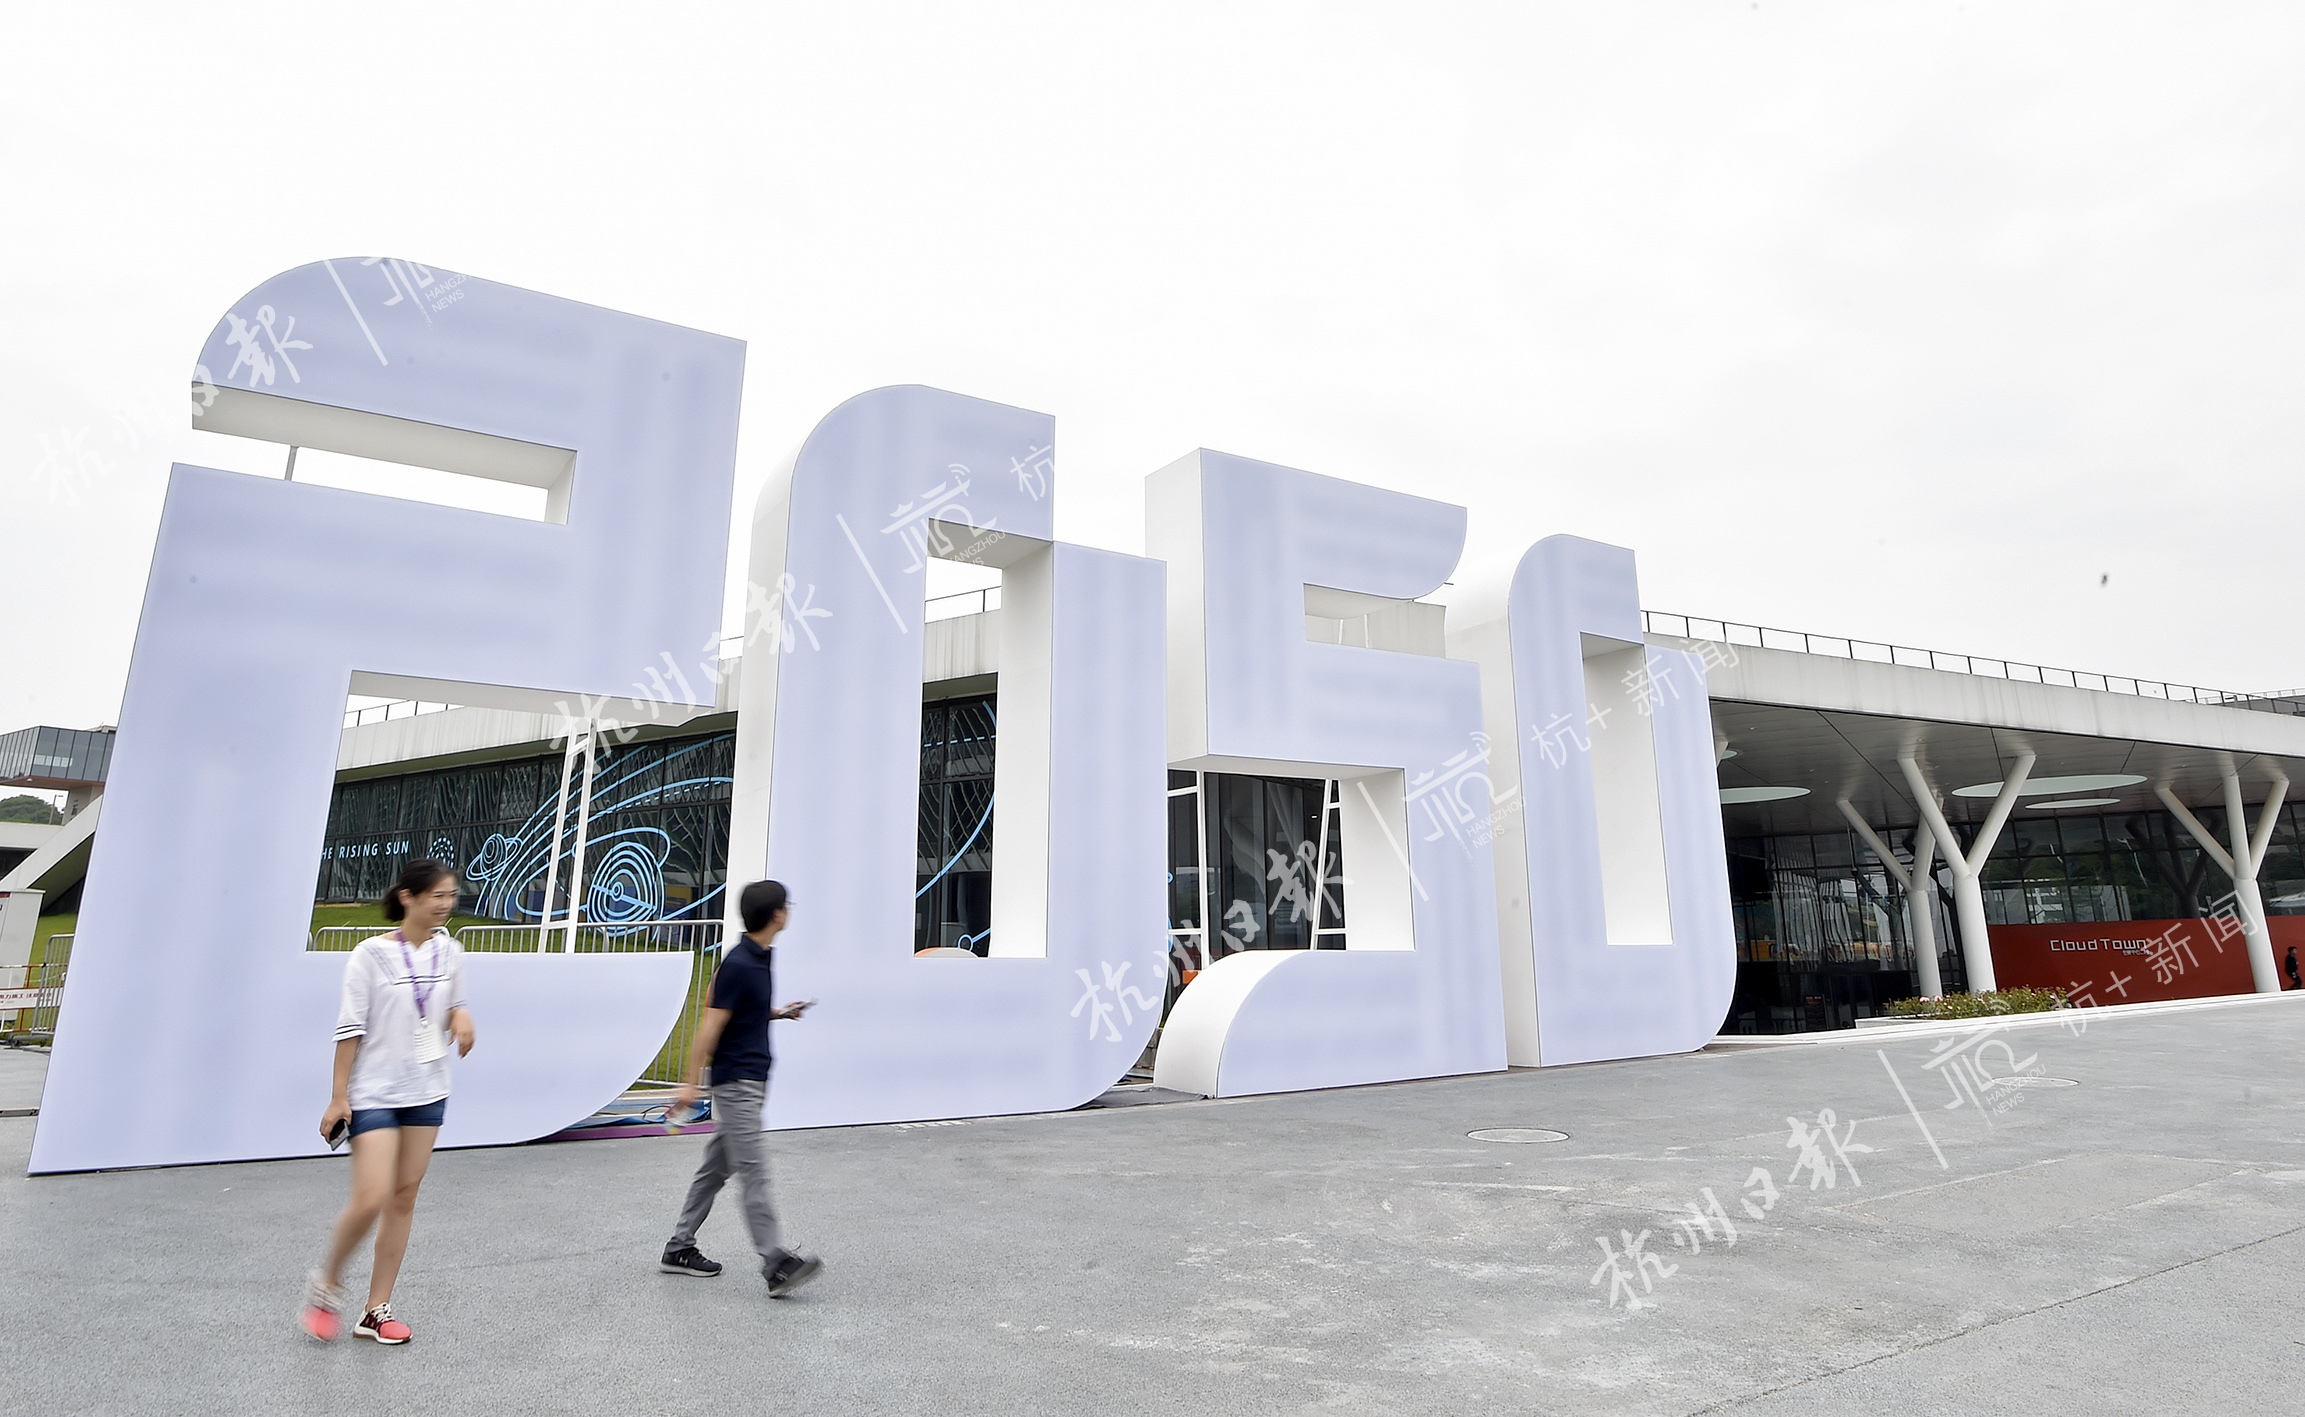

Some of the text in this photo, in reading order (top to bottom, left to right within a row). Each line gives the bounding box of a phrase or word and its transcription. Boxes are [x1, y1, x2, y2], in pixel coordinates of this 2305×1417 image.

[30, 257, 1737, 1176] 2050
[320, 839, 410, 861] HE RISING SUN
[2049, 938, 2147, 952] Cloud Town
